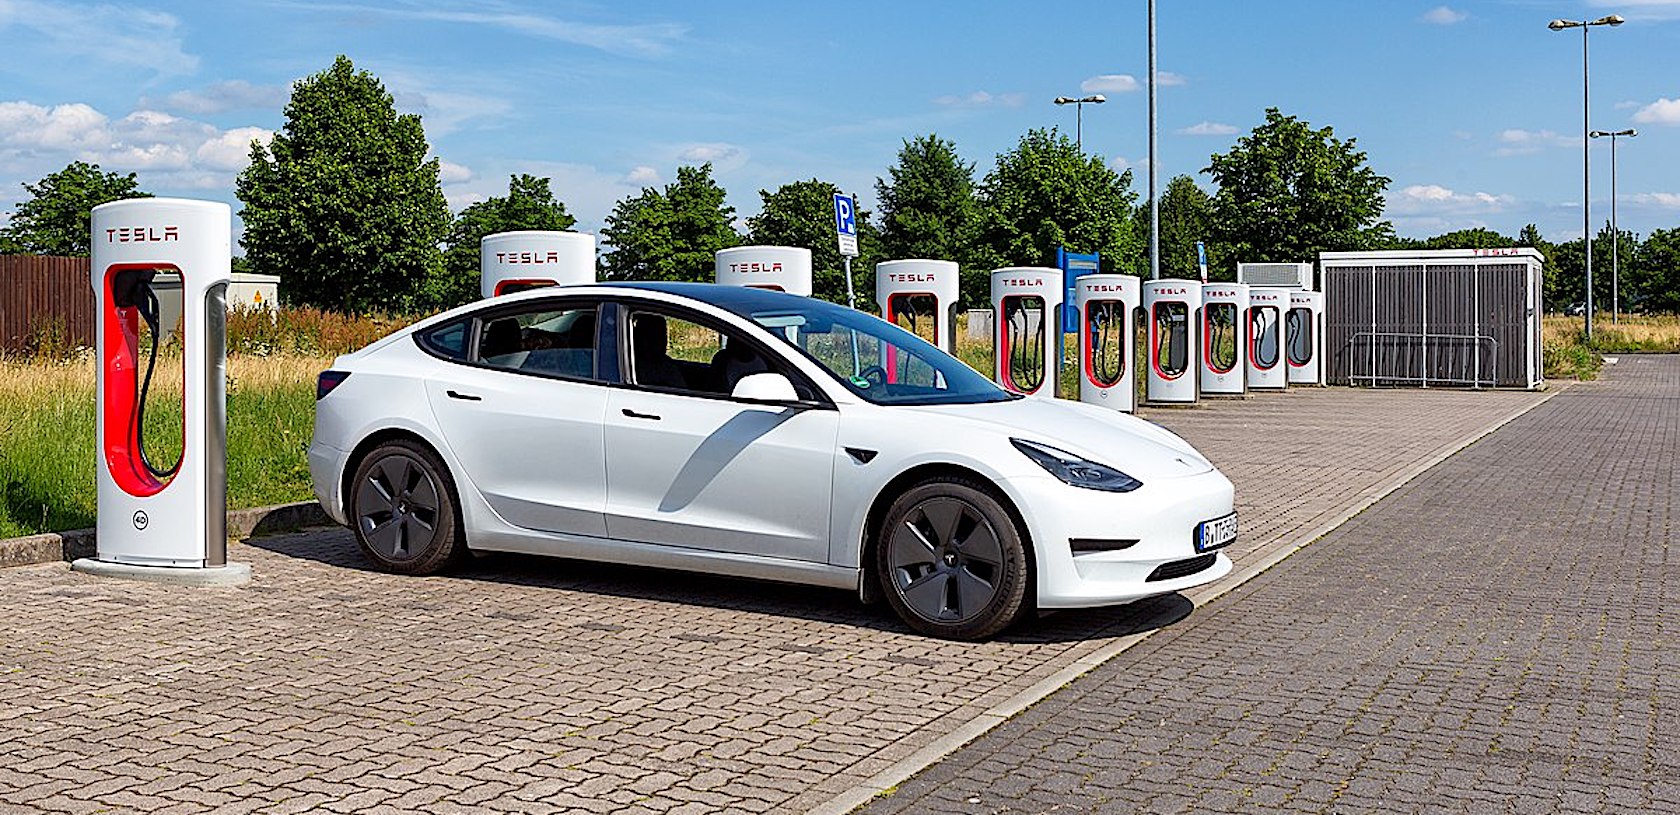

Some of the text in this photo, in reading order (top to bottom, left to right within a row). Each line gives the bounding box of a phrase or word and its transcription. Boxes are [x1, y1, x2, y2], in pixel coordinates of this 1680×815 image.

[838, 199, 850, 229] P
[106, 226, 178, 243] TESLA
[496, 252, 558, 264] TESLA
[730, 262, 783, 273] TESLA
[889, 274, 935, 282] TESLA
